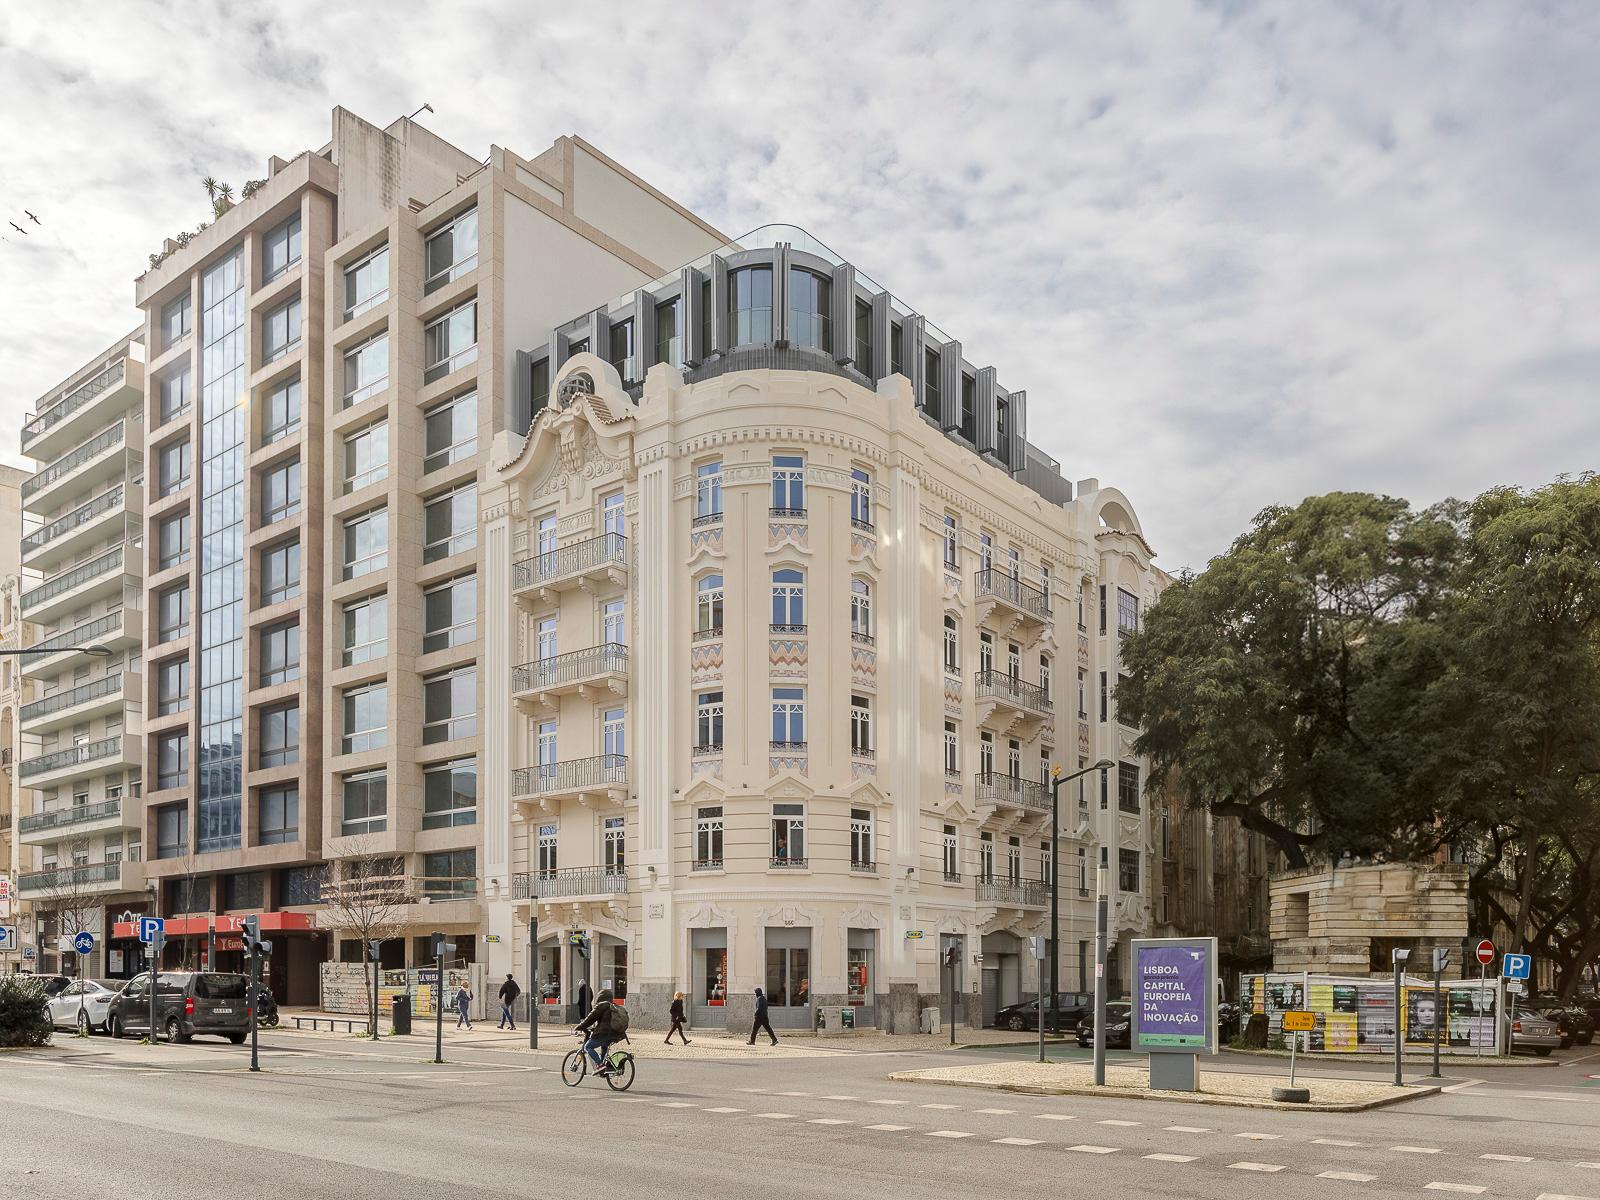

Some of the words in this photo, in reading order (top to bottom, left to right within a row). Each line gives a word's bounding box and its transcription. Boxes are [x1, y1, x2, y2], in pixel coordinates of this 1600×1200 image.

[145, 919, 159, 940] P
[1143, 966, 1179, 974] LISBOA
[1509, 957, 1524, 975] P
[1143, 982, 1185, 990] CAPITAL
[1143, 992, 1191, 1001] EUROPEIA
[1143, 1002, 1158, 1011] DA
[1143, 1012, 1199, 1025] INOVAÇÃO
